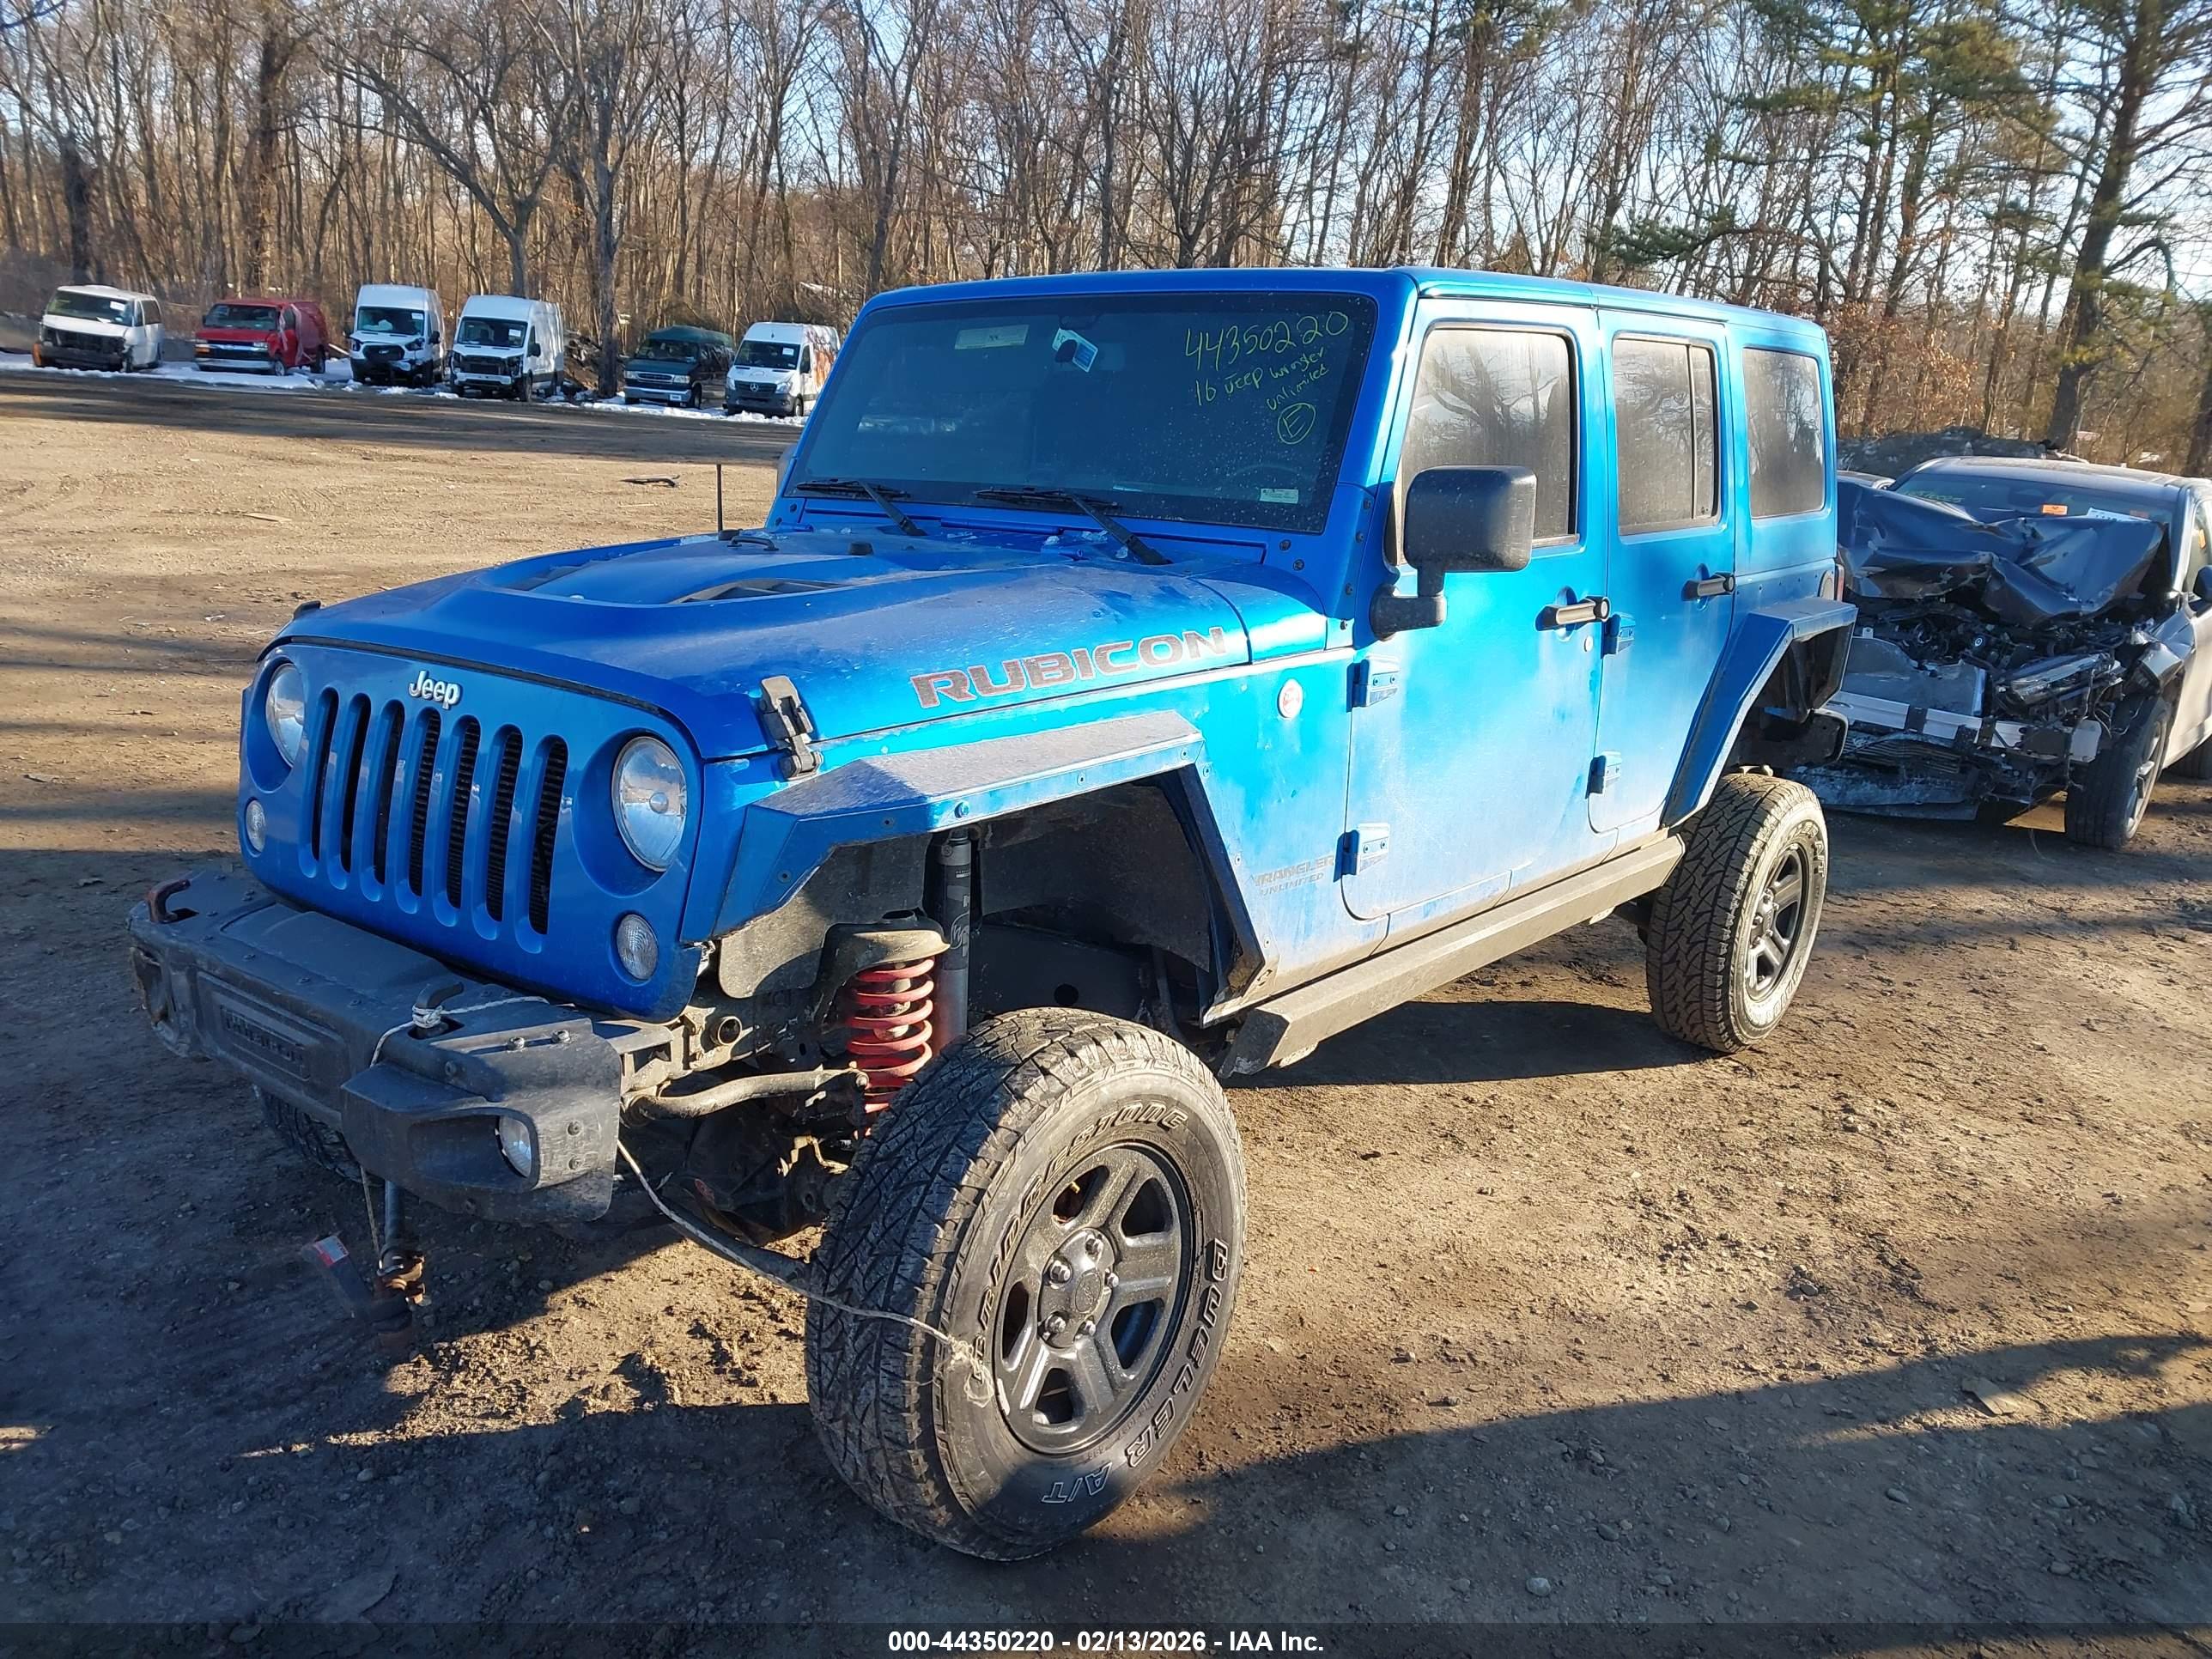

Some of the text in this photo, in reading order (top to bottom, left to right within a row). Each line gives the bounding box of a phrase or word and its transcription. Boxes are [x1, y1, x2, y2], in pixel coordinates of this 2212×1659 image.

[1185, 311, 1348, 371] 44350220
[1195, 379, 1216, 406] 16
[409, 669, 462, 710] Jeep
[909, 626, 1227, 708] RUBICON
[1125, 1237, 1229, 1468] DUELER
[1041, 1462, 1113, 1504] A/T
